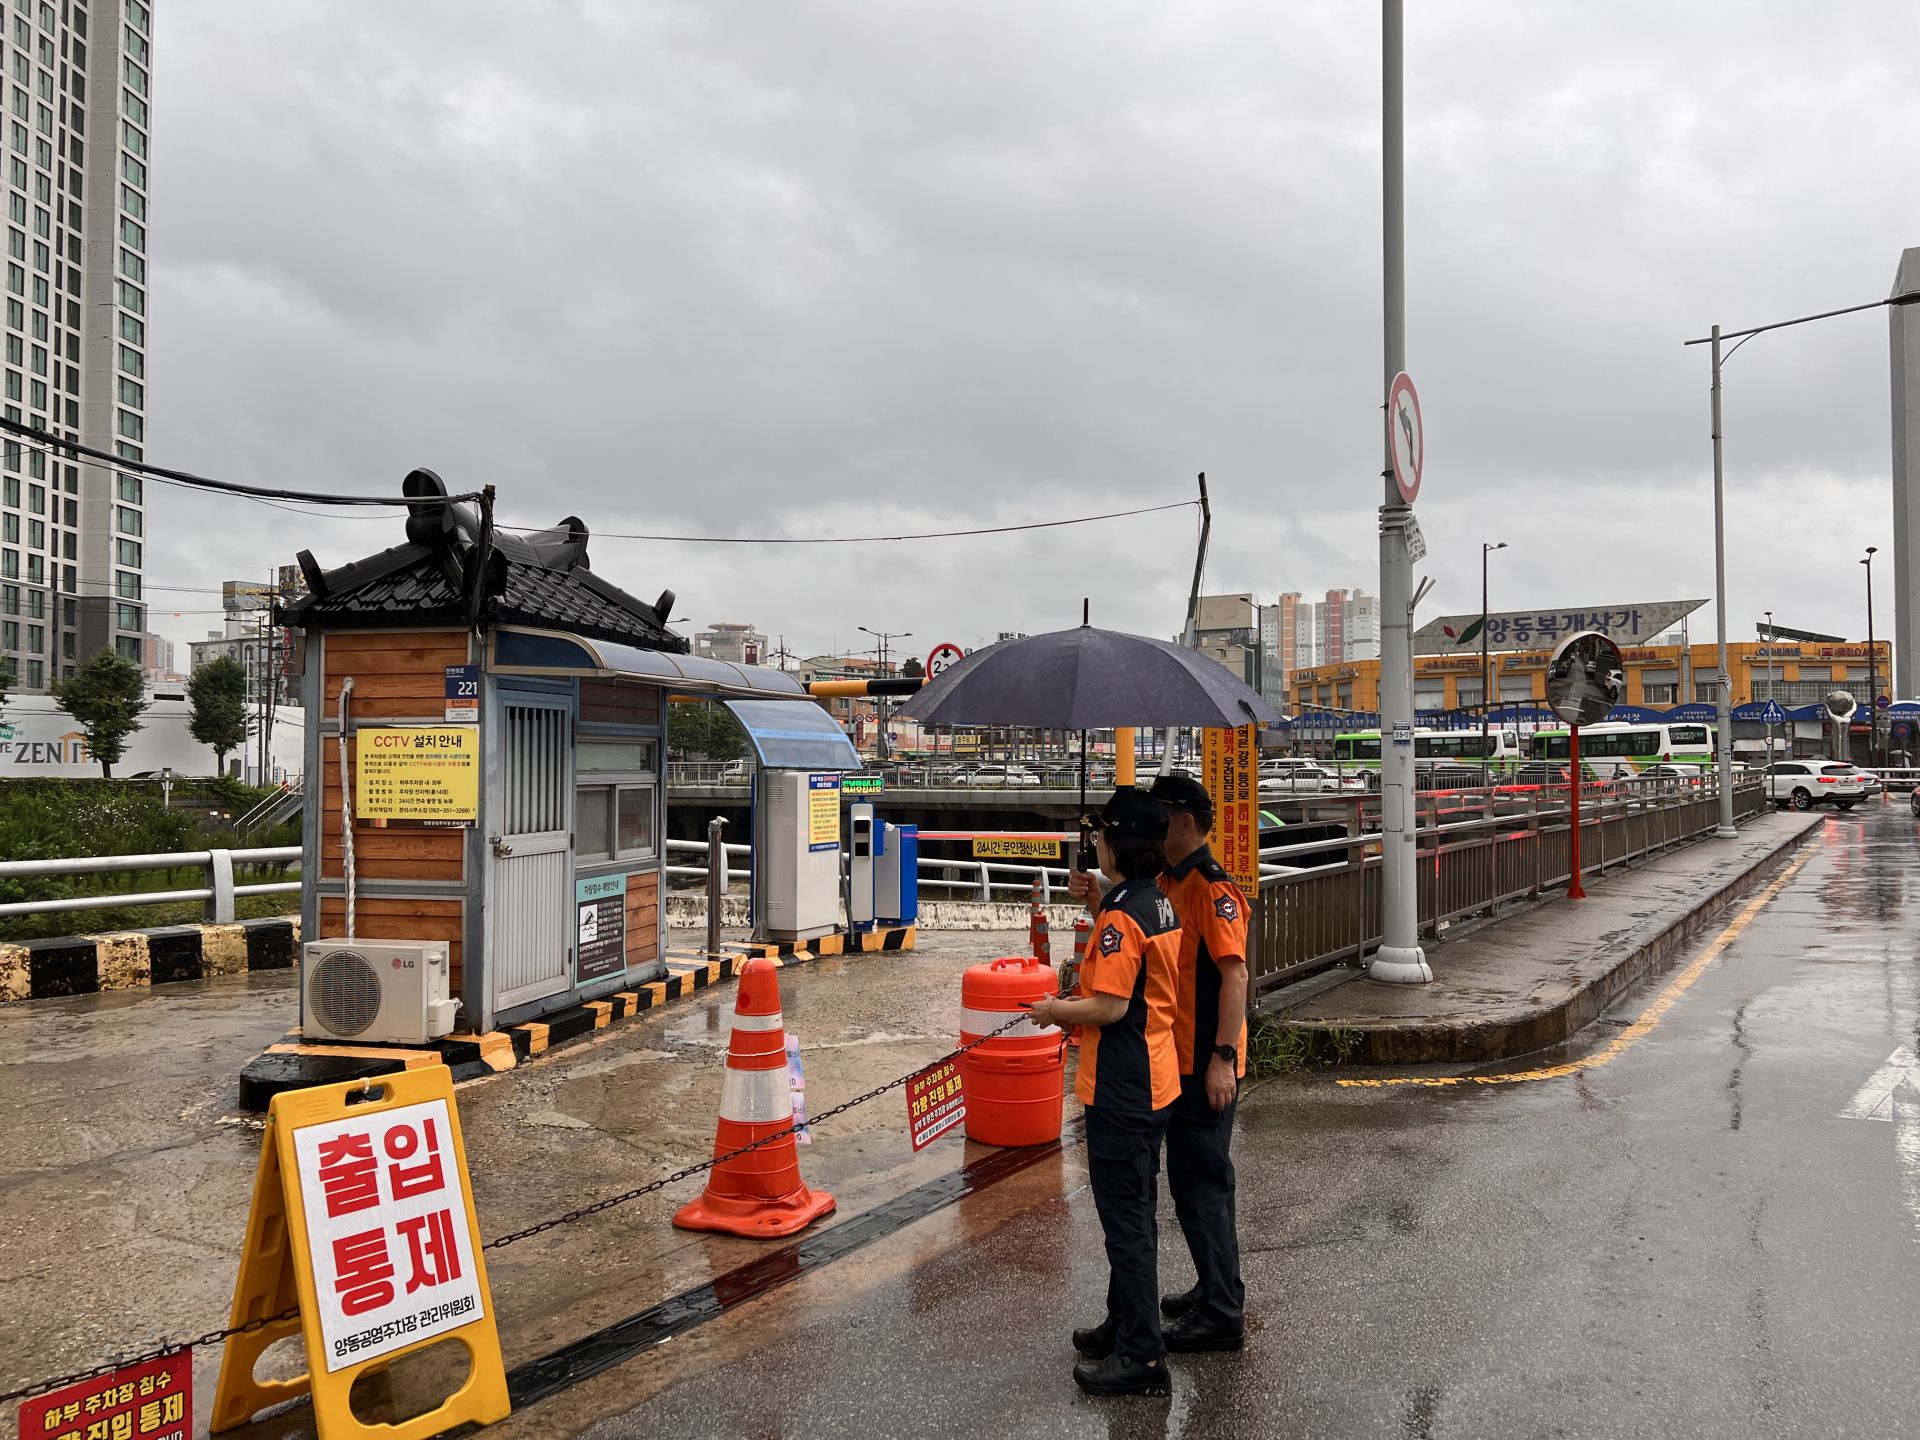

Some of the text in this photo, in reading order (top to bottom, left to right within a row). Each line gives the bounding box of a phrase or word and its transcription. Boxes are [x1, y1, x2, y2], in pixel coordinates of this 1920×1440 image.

[1486, 610, 1642, 643] 양동복개상가
[458, 681, 478, 695] 221
[374, 735, 462, 748] CCTV 설치 안내
[1238, 750, 1249, 770] 강우
[1238, 772, 1249, 801] 등으로
[1238, 802, 1249, 822] 물이
[977, 841, 1056, 855] 24시간 무인정산시스템
[1238, 824, 1250, 852] 불어날
[1223, 836, 1235, 874] 금합니다
[1238, 854, 1249, 874] 경우
[914, 1063, 955, 1095] 하부 주차장 침수
[912, 1074, 962, 1118] 차량 진입 통제
[318, 1118, 445, 1219] 출입
[332, 1208, 462, 1317] 통제
[334, 1295, 475, 1357] 양동공영주차장 관리위원회
[44, 1371, 172, 1431] 하부 주차장 침수
[139, 1392, 184, 1434] 통제
